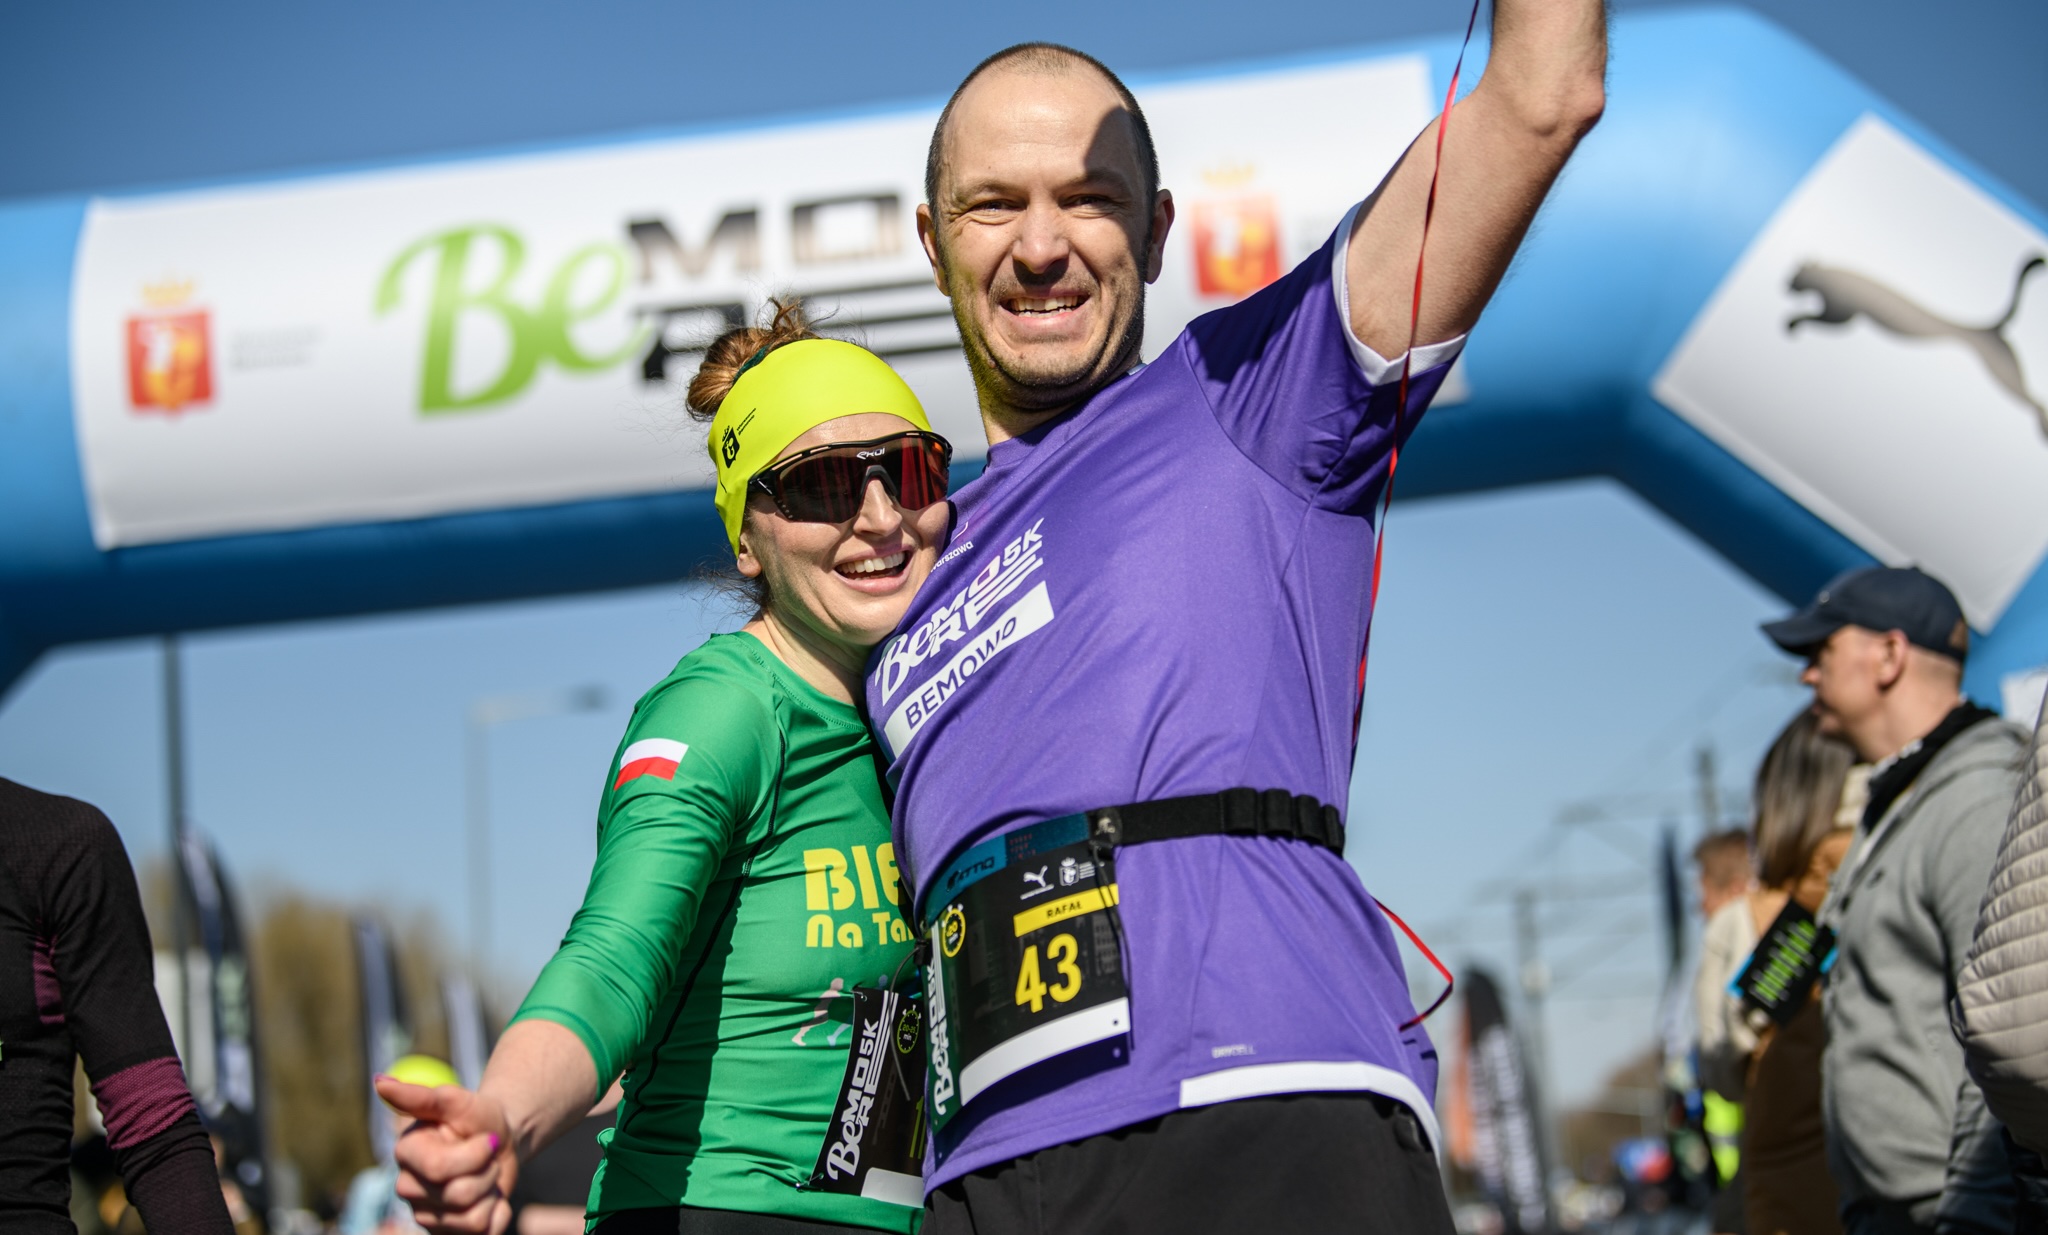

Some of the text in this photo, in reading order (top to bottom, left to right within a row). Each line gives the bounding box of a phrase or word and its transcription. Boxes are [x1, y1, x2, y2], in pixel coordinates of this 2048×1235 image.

[1002, 517, 1044, 568] 5K
[905, 616, 1017, 730] BEMOWO
[805, 913, 864, 949] Na
[1046, 900, 1083, 919] RAFAŁ
[1015, 932, 1082, 1014] 43
